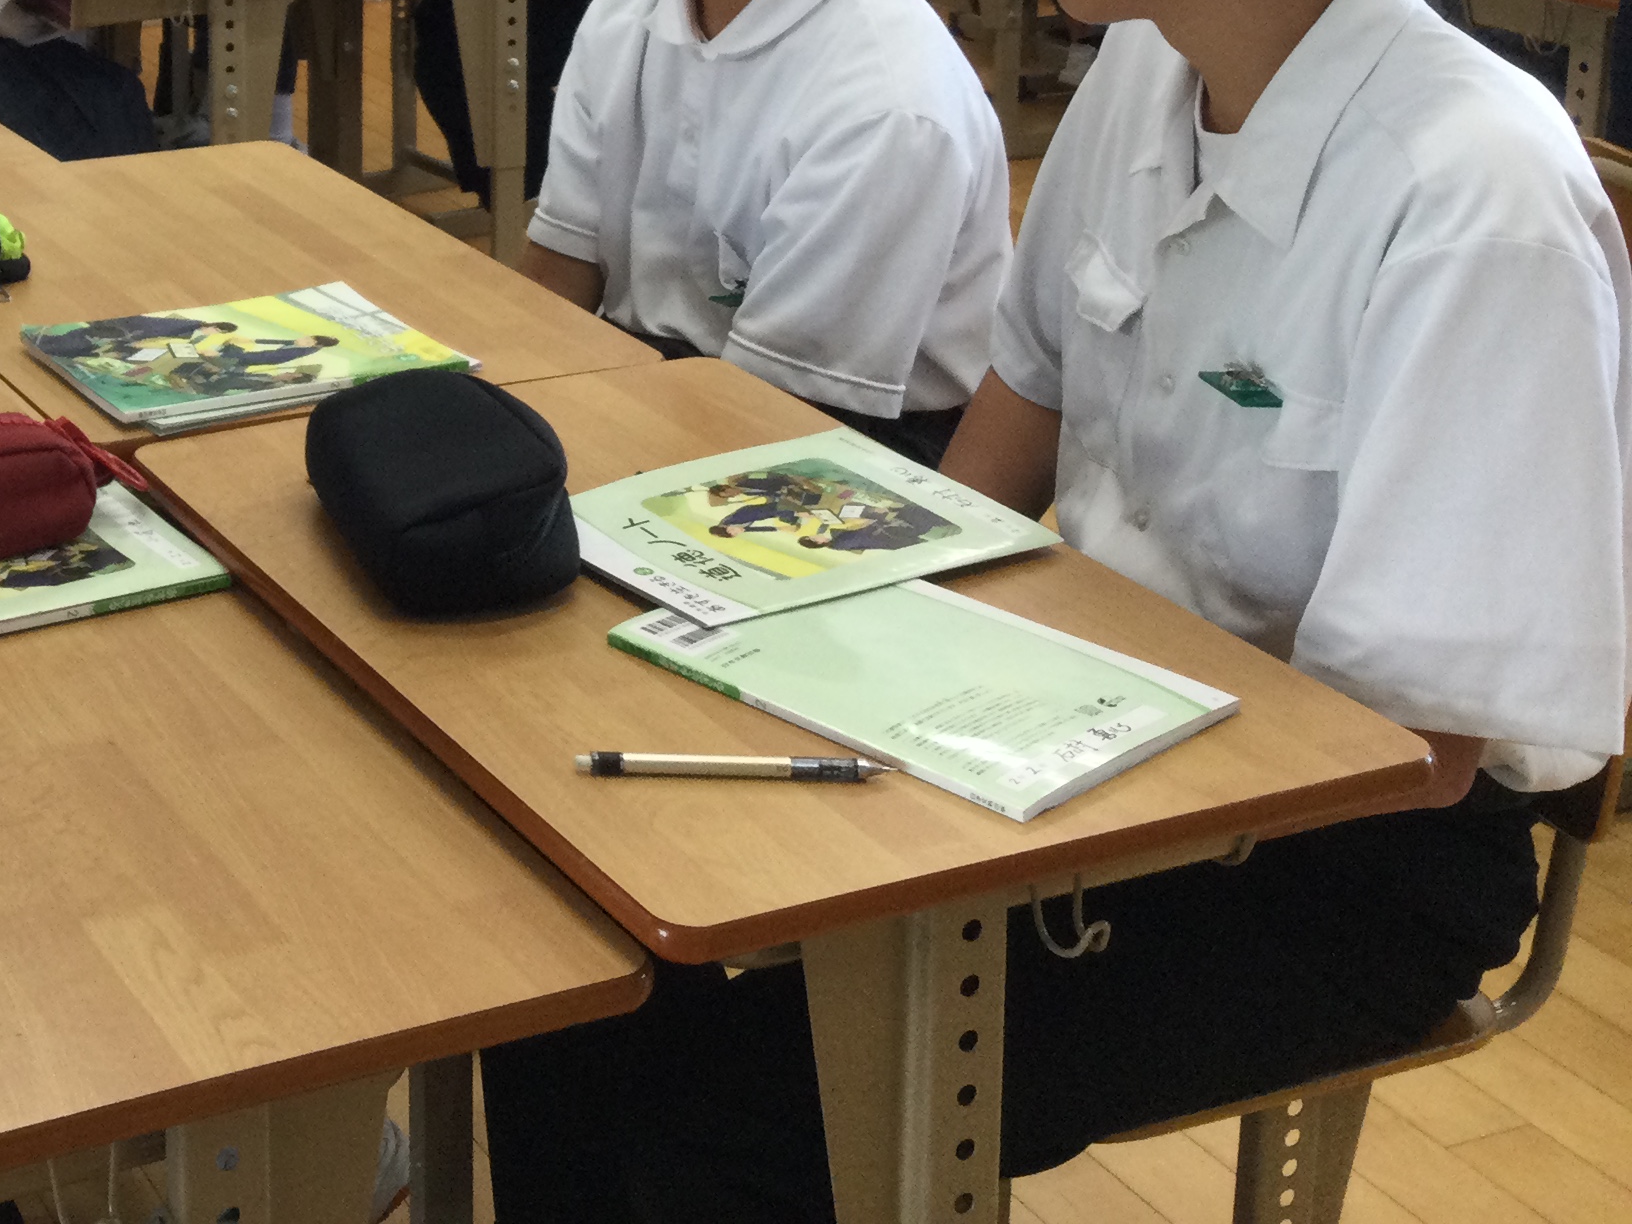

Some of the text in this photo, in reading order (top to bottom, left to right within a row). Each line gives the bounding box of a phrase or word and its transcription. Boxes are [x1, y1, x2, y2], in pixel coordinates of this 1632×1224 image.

[621, 515, 745, 582] 道徳ノート
